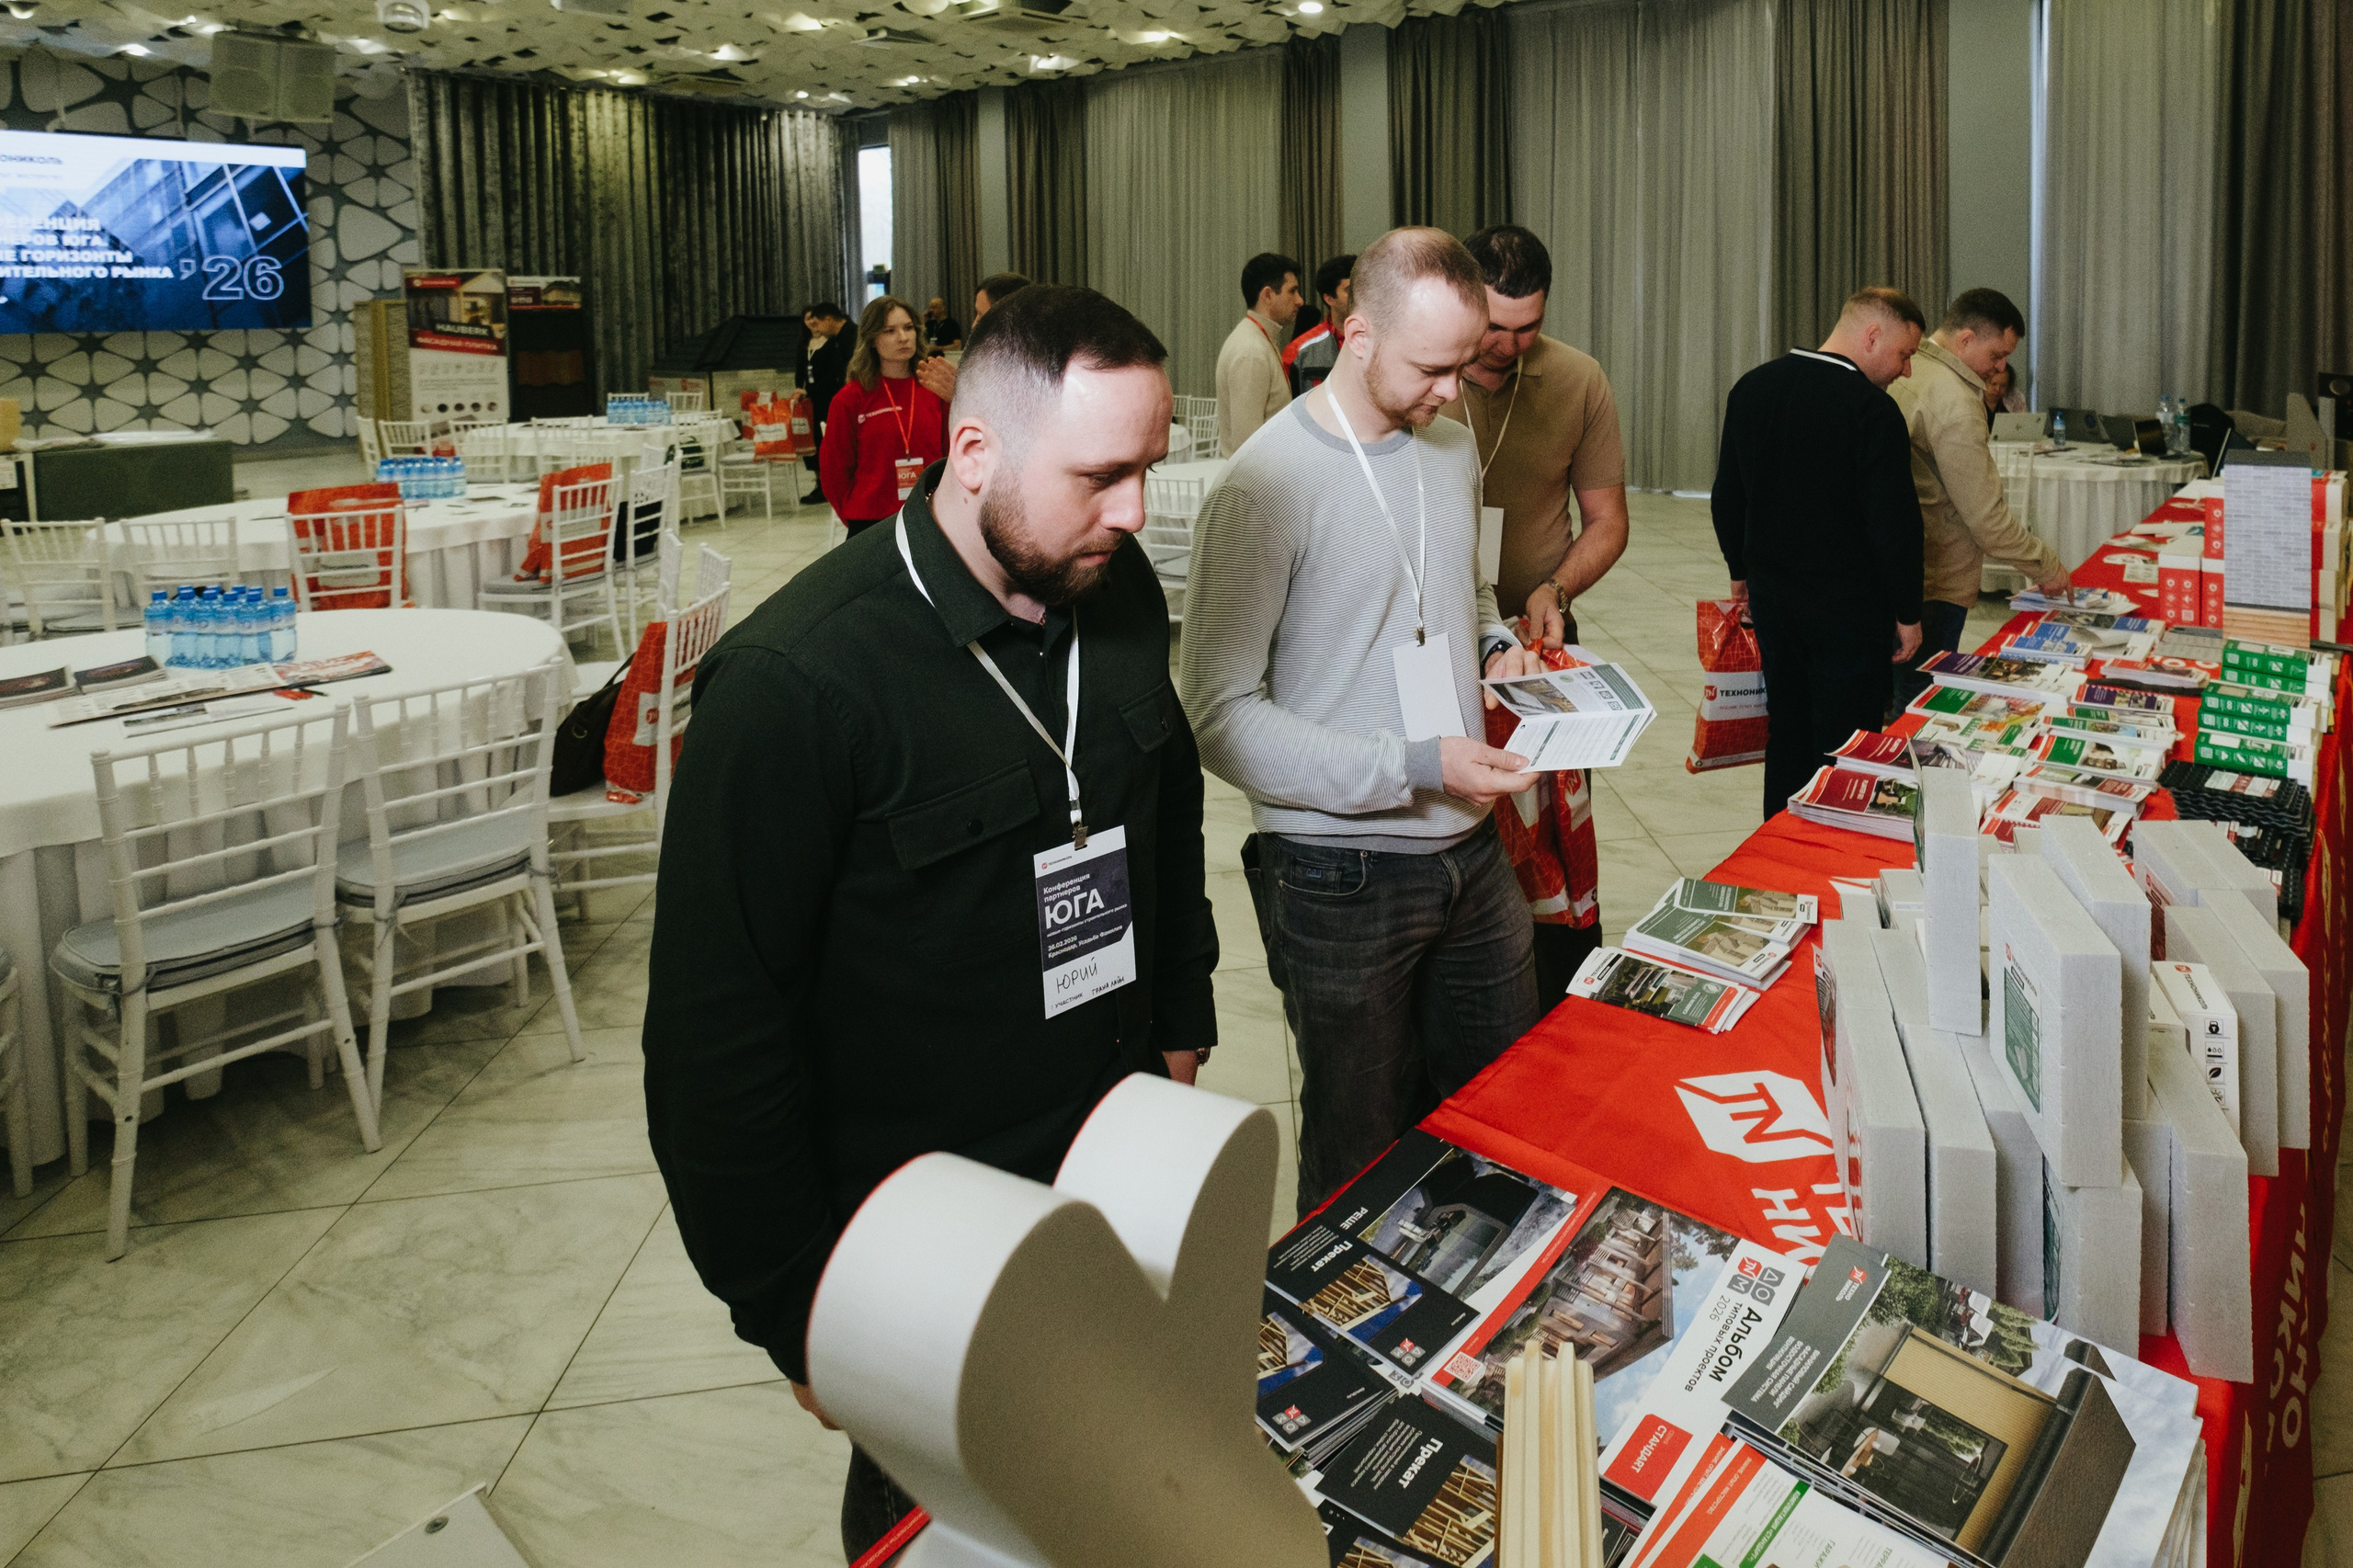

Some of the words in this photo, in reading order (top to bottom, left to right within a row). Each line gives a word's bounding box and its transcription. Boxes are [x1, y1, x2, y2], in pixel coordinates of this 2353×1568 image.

[20, 249, 133, 263] ГОРИЗОНТЫ
[110, 266, 175, 278] РЫНКА
[435, 323, 490, 336] HAUBERK
[897, 472, 917, 480] ЮГА
[1042, 873, 1090, 895] Конференция
[1044, 884, 1081, 903] партнеров
[1045, 889, 1104, 929] ЮГА
[1057, 957, 1097, 994] ЮРИЙ
[1311, 1239, 1353, 1273] Прекат
[1836, 1278, 1854, 1302] НИКОЛЬ
[1844, 1282, 1859, 1301] ТЕХНО
[1709, 1294, 1730, 1323] 2026
[1713, 1301, 1744, 1345] типовых
[1708, 1306, 1764, 1384] Альбом
[1766, 1335, 1795, 1370] ВЕНТИЛЯЦИЯ
[1770, 1339, 1803, 1380] ВОДОСТОЧНАЯ
[1786, 1344, 1811, 1376] ФАСАДНЫЕ
[1685, 1344, 1718, 1393] проектов
[1791, 1349, 1821, 1385] ВИНИЛОВЫЙ
[1751, 1377, 1775, 1403] СИСТЕМА
[1769, 1372, 1790, 1397] ПАНЕЛИ
[1772, 1382, 1795, 1409] САЙДИНГ
[1397, 1435, 1443, 1489] Прекат
[1631, 1425, 1667, 1473] СТАНДАРТ
[1770, 1490, 1802, 1530] КОМПЛЕКТАЦИЯ
